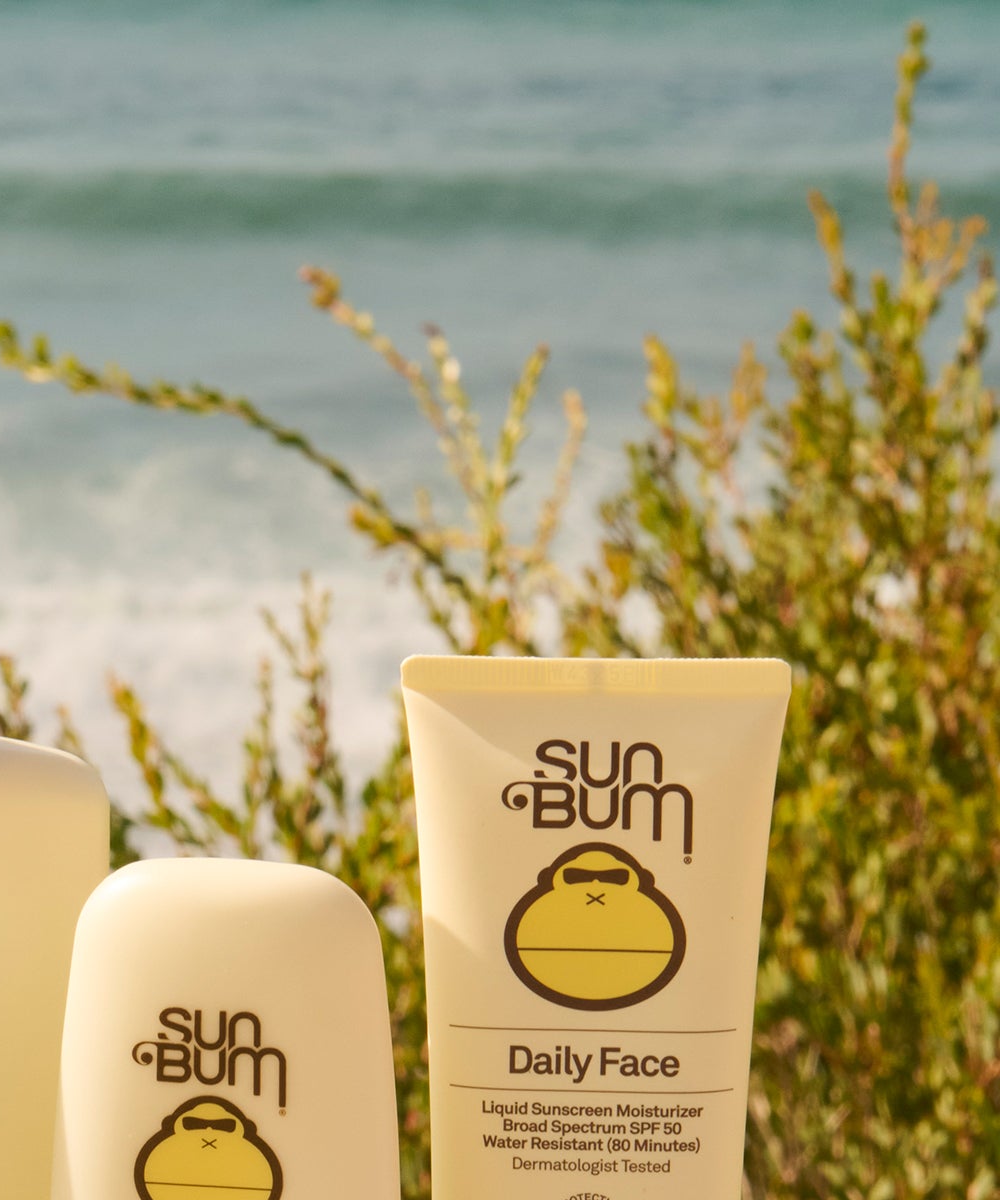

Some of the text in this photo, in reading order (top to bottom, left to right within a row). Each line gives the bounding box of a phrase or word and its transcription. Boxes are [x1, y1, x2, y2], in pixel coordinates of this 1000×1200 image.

[510, 1045, 680, 1083] Daily Face
[482, 1101, 703, 1118] Liquid Sunscreen Moisturizer
[503, 1119, 681, 1136] Broad Spectrum SPF 50
[483, 1135, 700, 1154] Water Resistant (80 Minutes)
[513, 1157, 670, 1176] Dermatologist Tested
